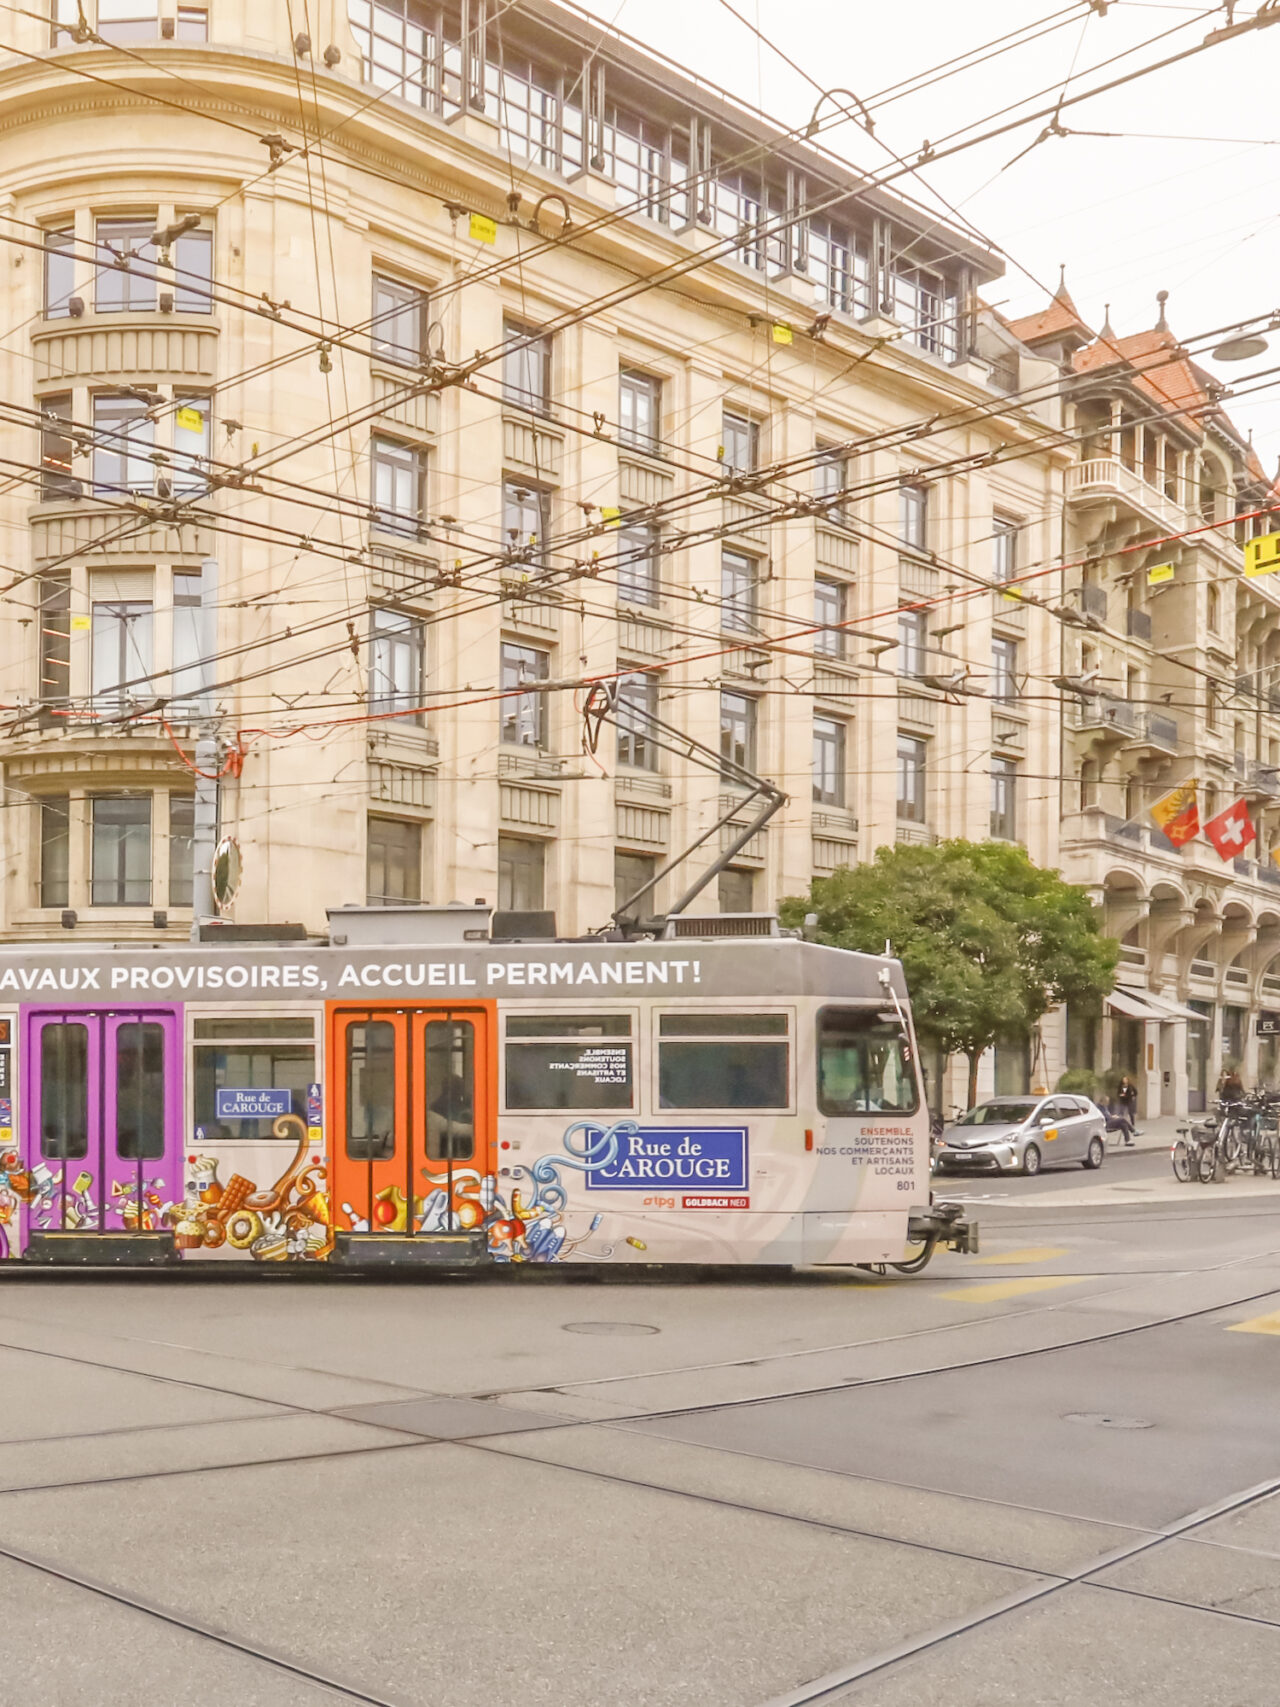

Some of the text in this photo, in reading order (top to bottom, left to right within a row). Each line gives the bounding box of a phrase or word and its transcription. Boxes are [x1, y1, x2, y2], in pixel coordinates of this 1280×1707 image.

[111, 965, 328, 991] PROVISOIRES,
[338, 964, 476, 986] ACCUEIL
[487, 960, 702, 986] PERMANENT!
[236, 1092, 271, 1102] Rue de
[223, 1103, 284, 1113] CAROUGE
[860, 1128, 914, 1136] ENSEMBLE,
[628, 1137, 702, 1156] Rue de
[854, 1138, 914, 1146] SOUTENONS
[816, 1147, 914, 1156] NOS COMMERÇANTS
[852, 1157, 914, 1165] ET ARTISANS
[600, 1159, 730, 1178] CAROUGE
[875, 1167, 914, 1175] LOCAUX
[897, 1181, 915, 1190] 801
[655, 1197, 675, 1208] tpg
[685, 1198, 728, 1207] GOLDBACH
